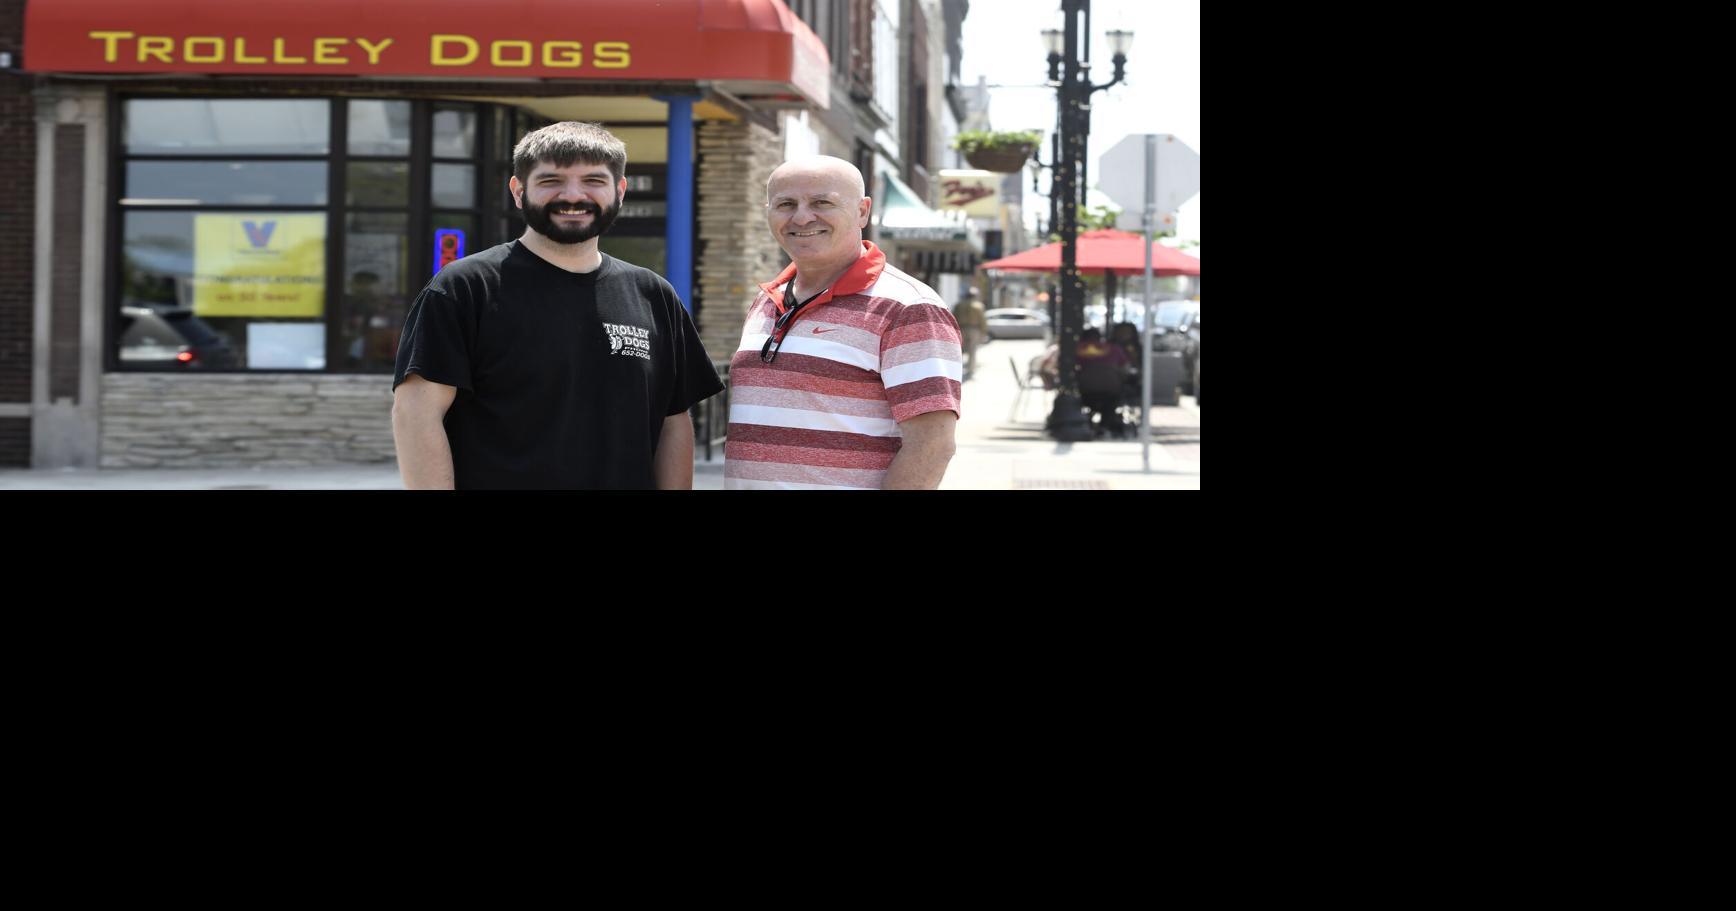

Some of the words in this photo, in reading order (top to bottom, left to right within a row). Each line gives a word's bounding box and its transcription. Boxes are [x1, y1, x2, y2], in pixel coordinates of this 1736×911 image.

[89, 31, 393, 65] TROLLEY
[431, 34, 631, 68] DOGS
[602, 322, 649, 339] TROLLEY
[623, 335, 650, 351] DOGS
